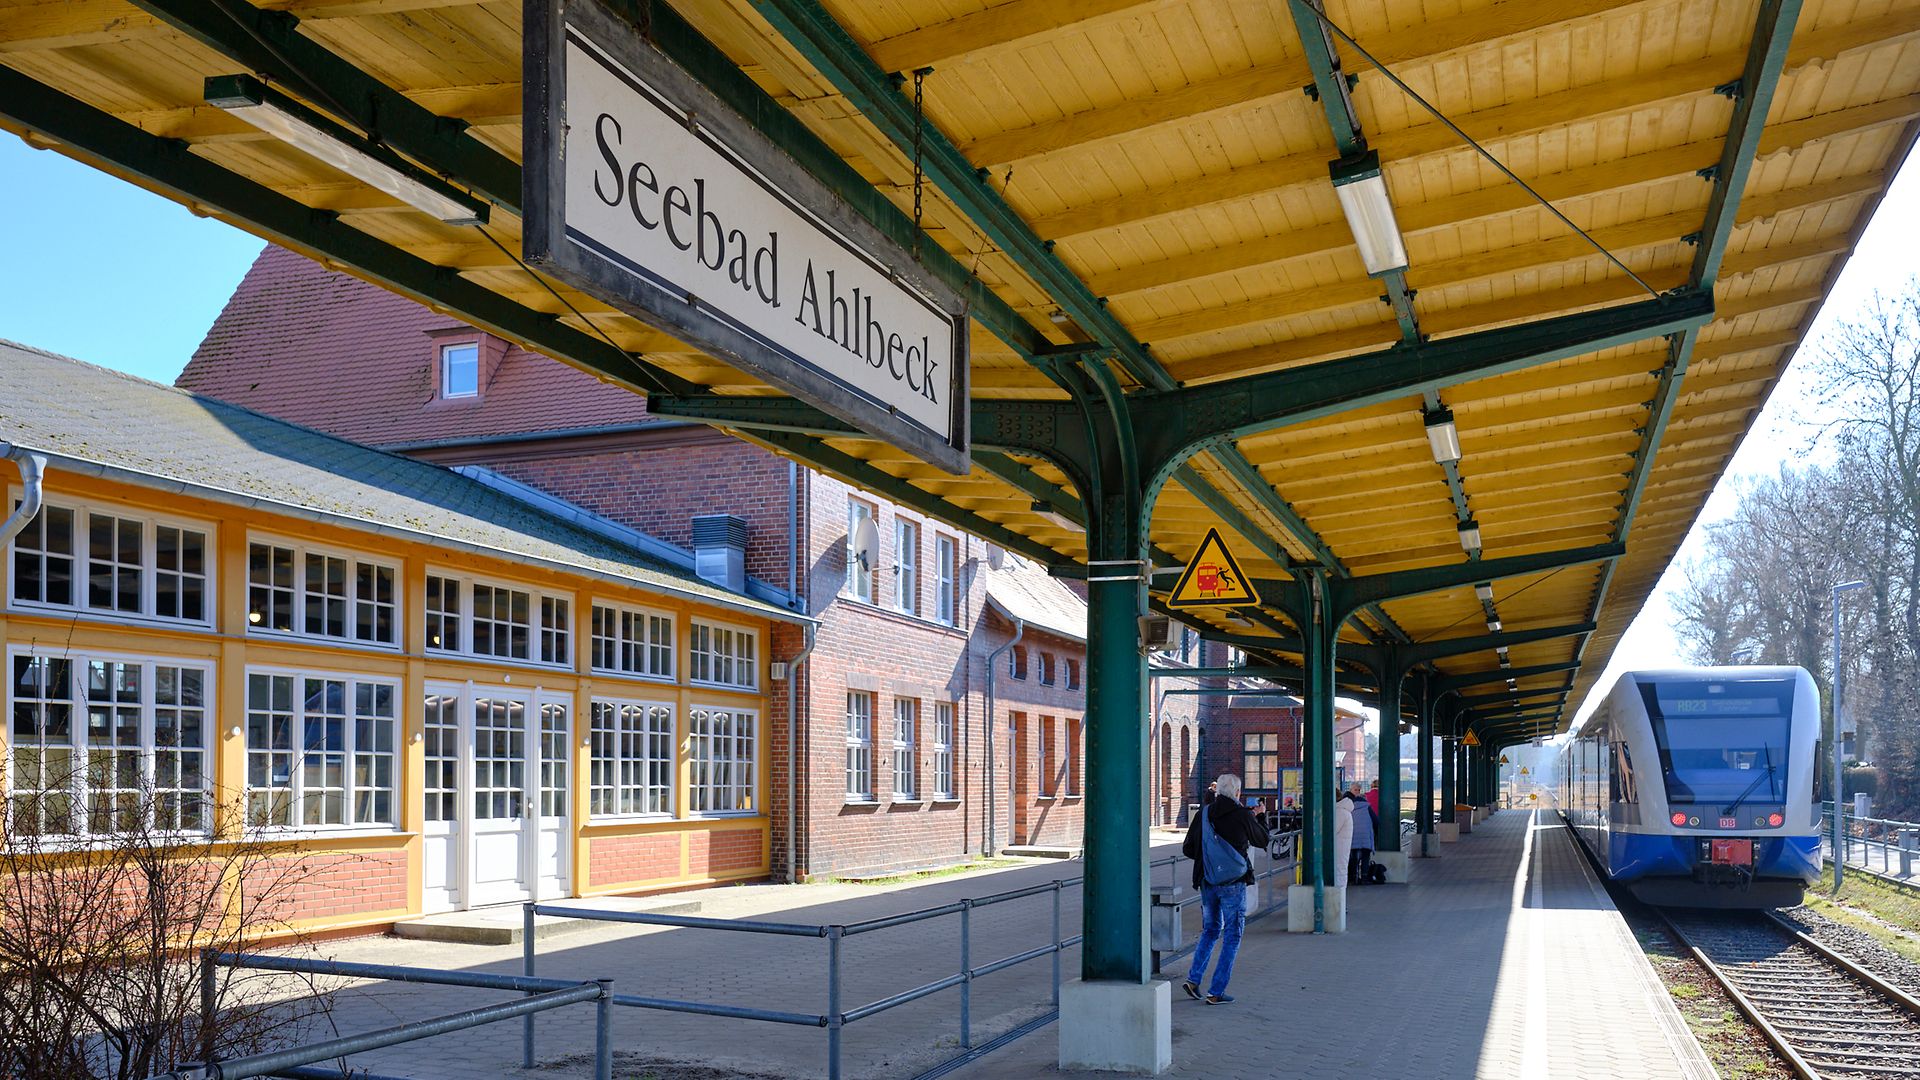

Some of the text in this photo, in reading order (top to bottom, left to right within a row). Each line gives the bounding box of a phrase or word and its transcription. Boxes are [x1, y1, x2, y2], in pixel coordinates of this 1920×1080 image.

[594, 113, 938, 405] Seebad Ahlbeck
[1677, 700, 1707, 712] RB23
[1720, 818, 1735, 828] DB
